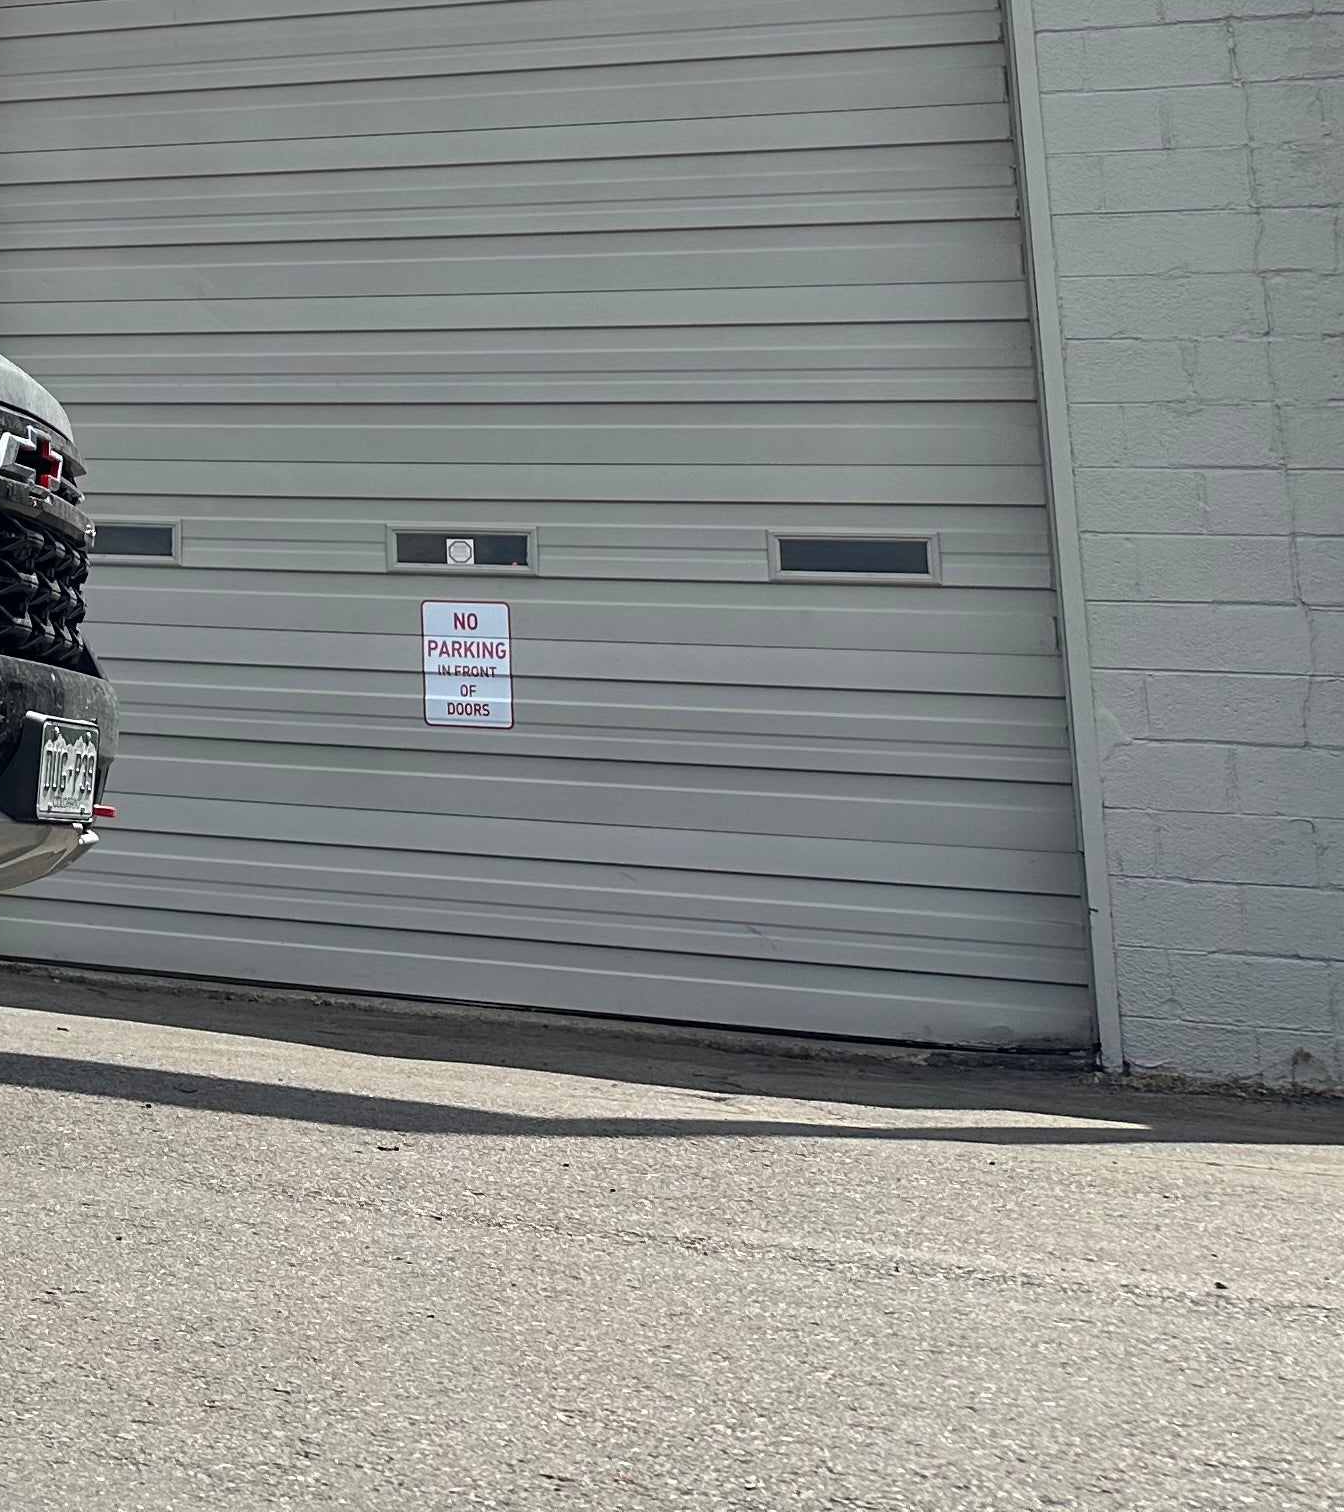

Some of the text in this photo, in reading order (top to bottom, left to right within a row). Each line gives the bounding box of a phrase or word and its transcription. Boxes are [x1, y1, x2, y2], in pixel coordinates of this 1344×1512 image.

[453, 612, 479, 631] NO
[427, 639, 508, 660] PARKING
[437, 664, 497, 678] IN FRONT
[460, 684, 477, 698] OF
[447, 702, 491, 717] DOORS
